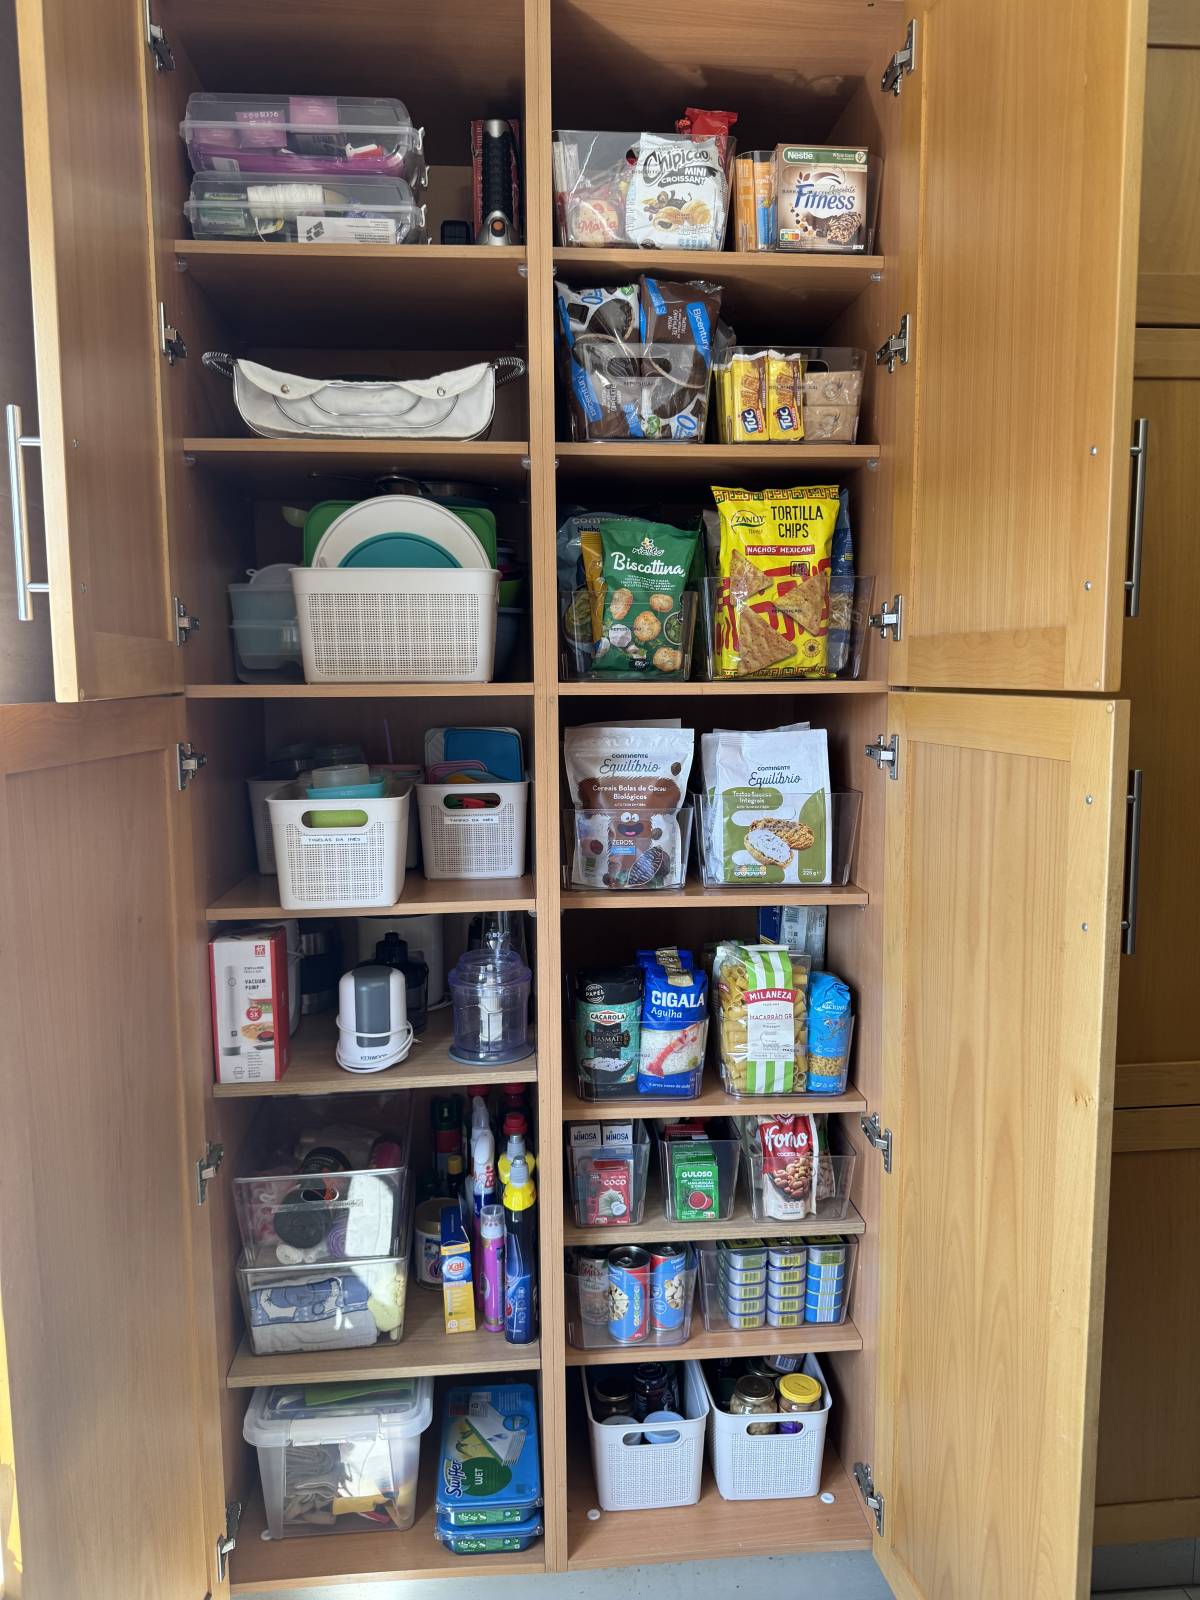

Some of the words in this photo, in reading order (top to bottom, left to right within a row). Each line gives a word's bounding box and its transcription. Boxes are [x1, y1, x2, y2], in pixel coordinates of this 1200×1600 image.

[660, 175, 706, 185] CROISSANT
[684, 167, 707, 177] MINI
[794, 183, 856, 210] Fitness
[692, 308, 711, 351] Bicentury
[744, 410, 759, 431] TUC
[779, 407, 793, 429] TUC
[770, 505, 824, 521] TORTILLA
[777, 523, 809, 539] CHIPS
[610, 551, 686, 578] Biscottina
[600, 758, 662, 777] Equilíbrio
[592, 784, 617, 792] Cereais
[618, 784, 637, 792] Bolas
[638, 784, 647, 792] de
[748, 771, 802, 790] Equilíbrio
[613, 793, 648, 801] Biológicos
[651, 990, 705, 1008] CIGALA
[749, 991, 792, 1001] MILANEZA
[650, 1006, 683, 1019] Agulha
[573, 1132, 597, 1141] MIMOSA
[605, 1132, 629, 1142] MIMOSA
[681, 1170, 713, 1178] GULOSO
[445, 1459, 465, 1498] Swiffer
[474, 1467, 484, 1486] WET
